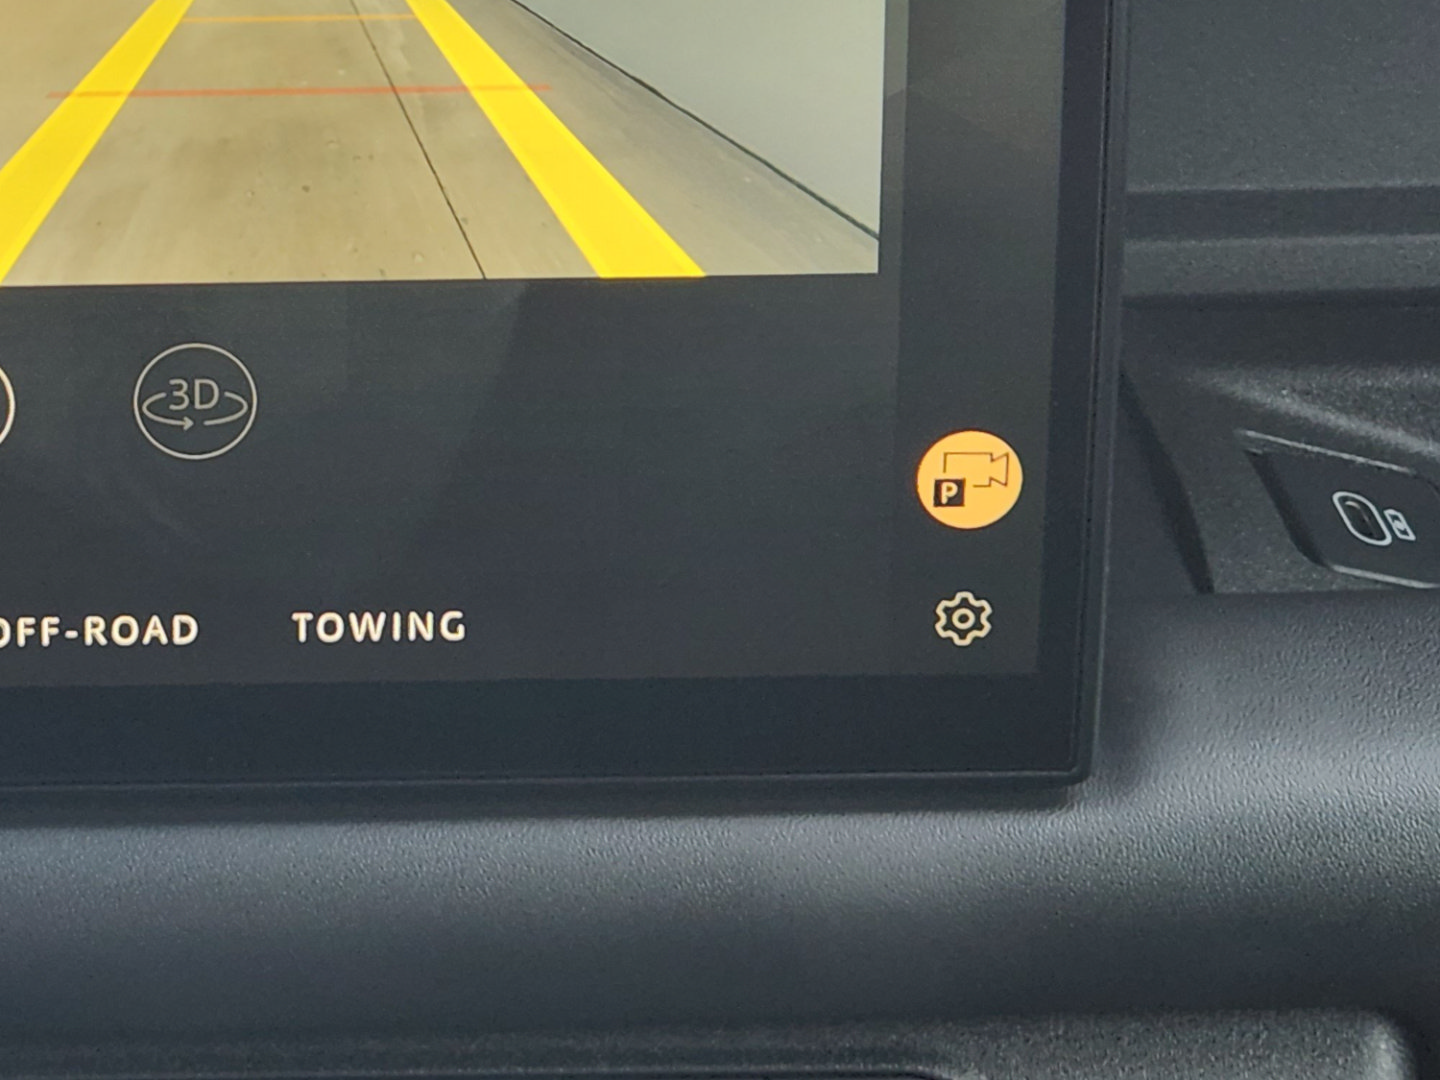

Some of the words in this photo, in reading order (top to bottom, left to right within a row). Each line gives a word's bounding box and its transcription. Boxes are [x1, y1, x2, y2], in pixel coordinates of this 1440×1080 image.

[168, 378, 220, 411] 3D
[940, 481, 959, 505] P
[291, 610, 467, 643] TOWING
